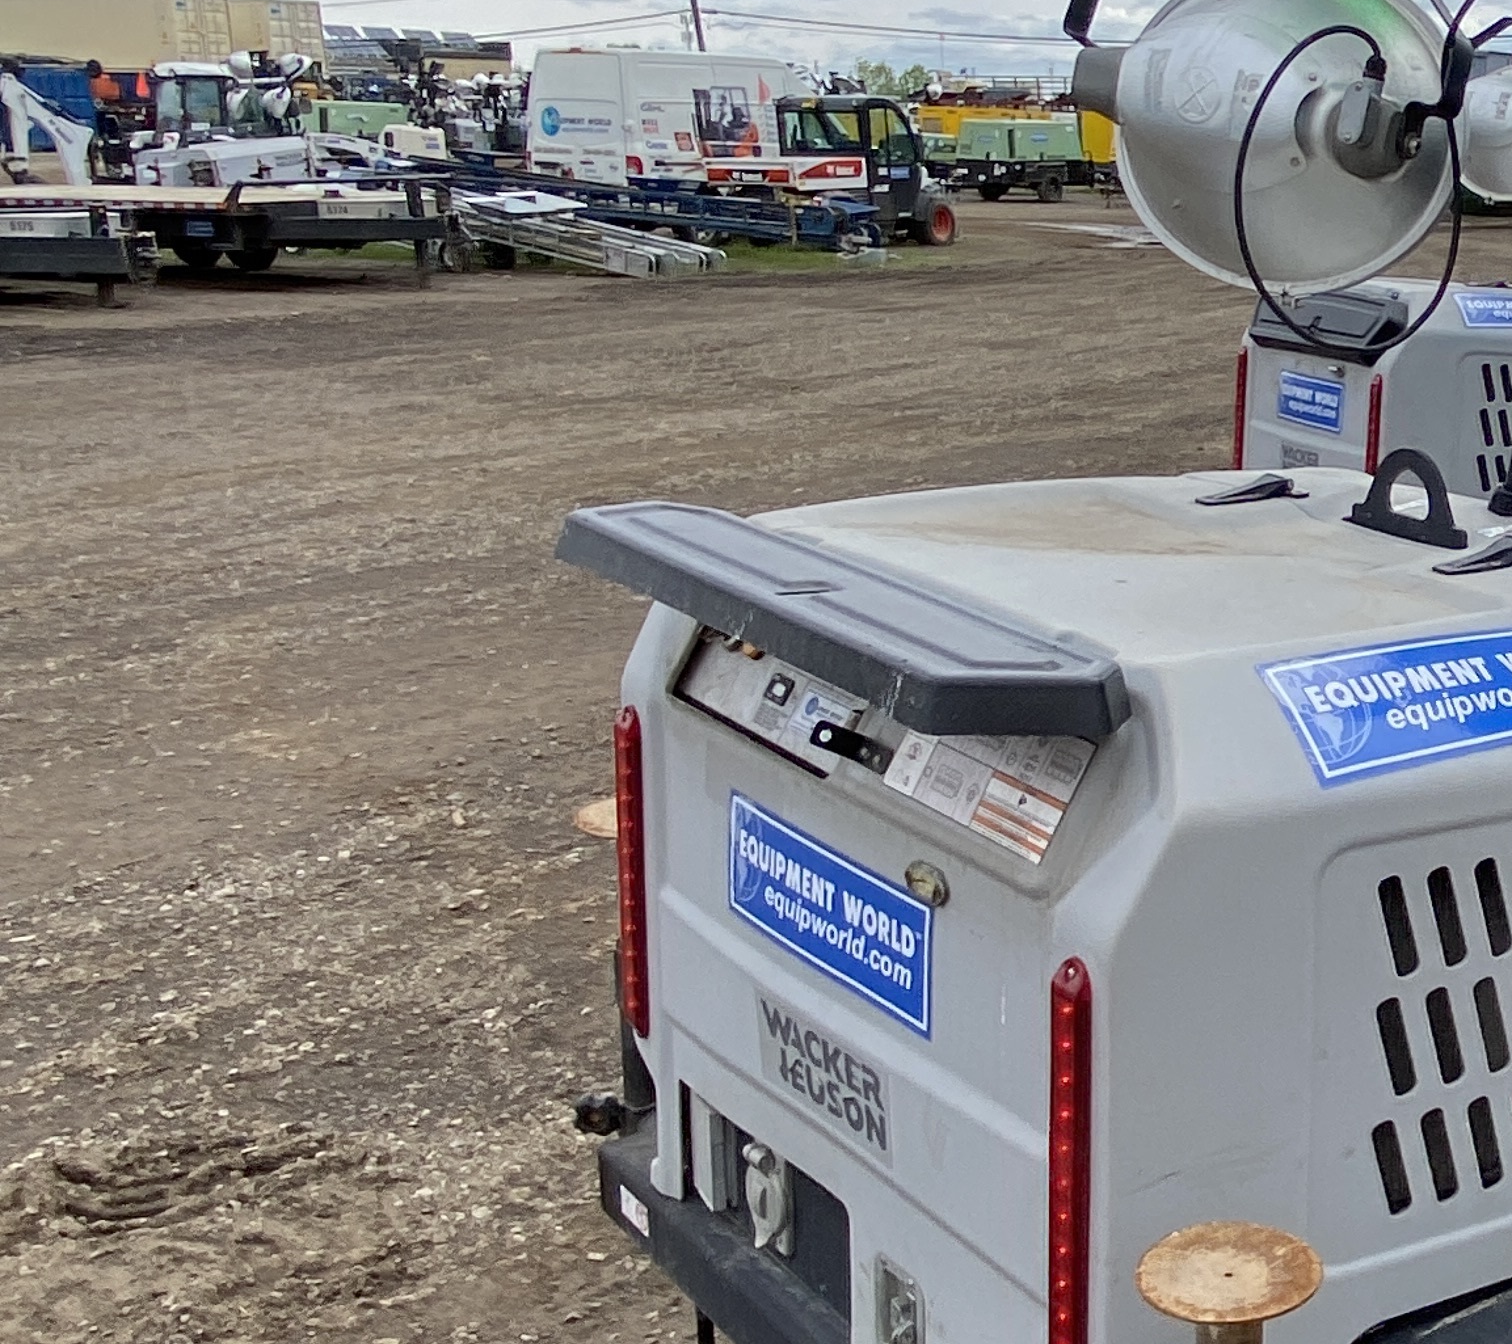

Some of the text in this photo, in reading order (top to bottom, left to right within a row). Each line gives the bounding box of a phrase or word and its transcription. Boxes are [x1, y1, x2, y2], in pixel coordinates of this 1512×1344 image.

[1304, 656, 1490, 714] EQUIPMENT
[739, 828, 916, 958] EQUIPMENT WORLD
[764, 885, 913, 990] equipworld.com
[760, 997, 885, 1112] WACKER
